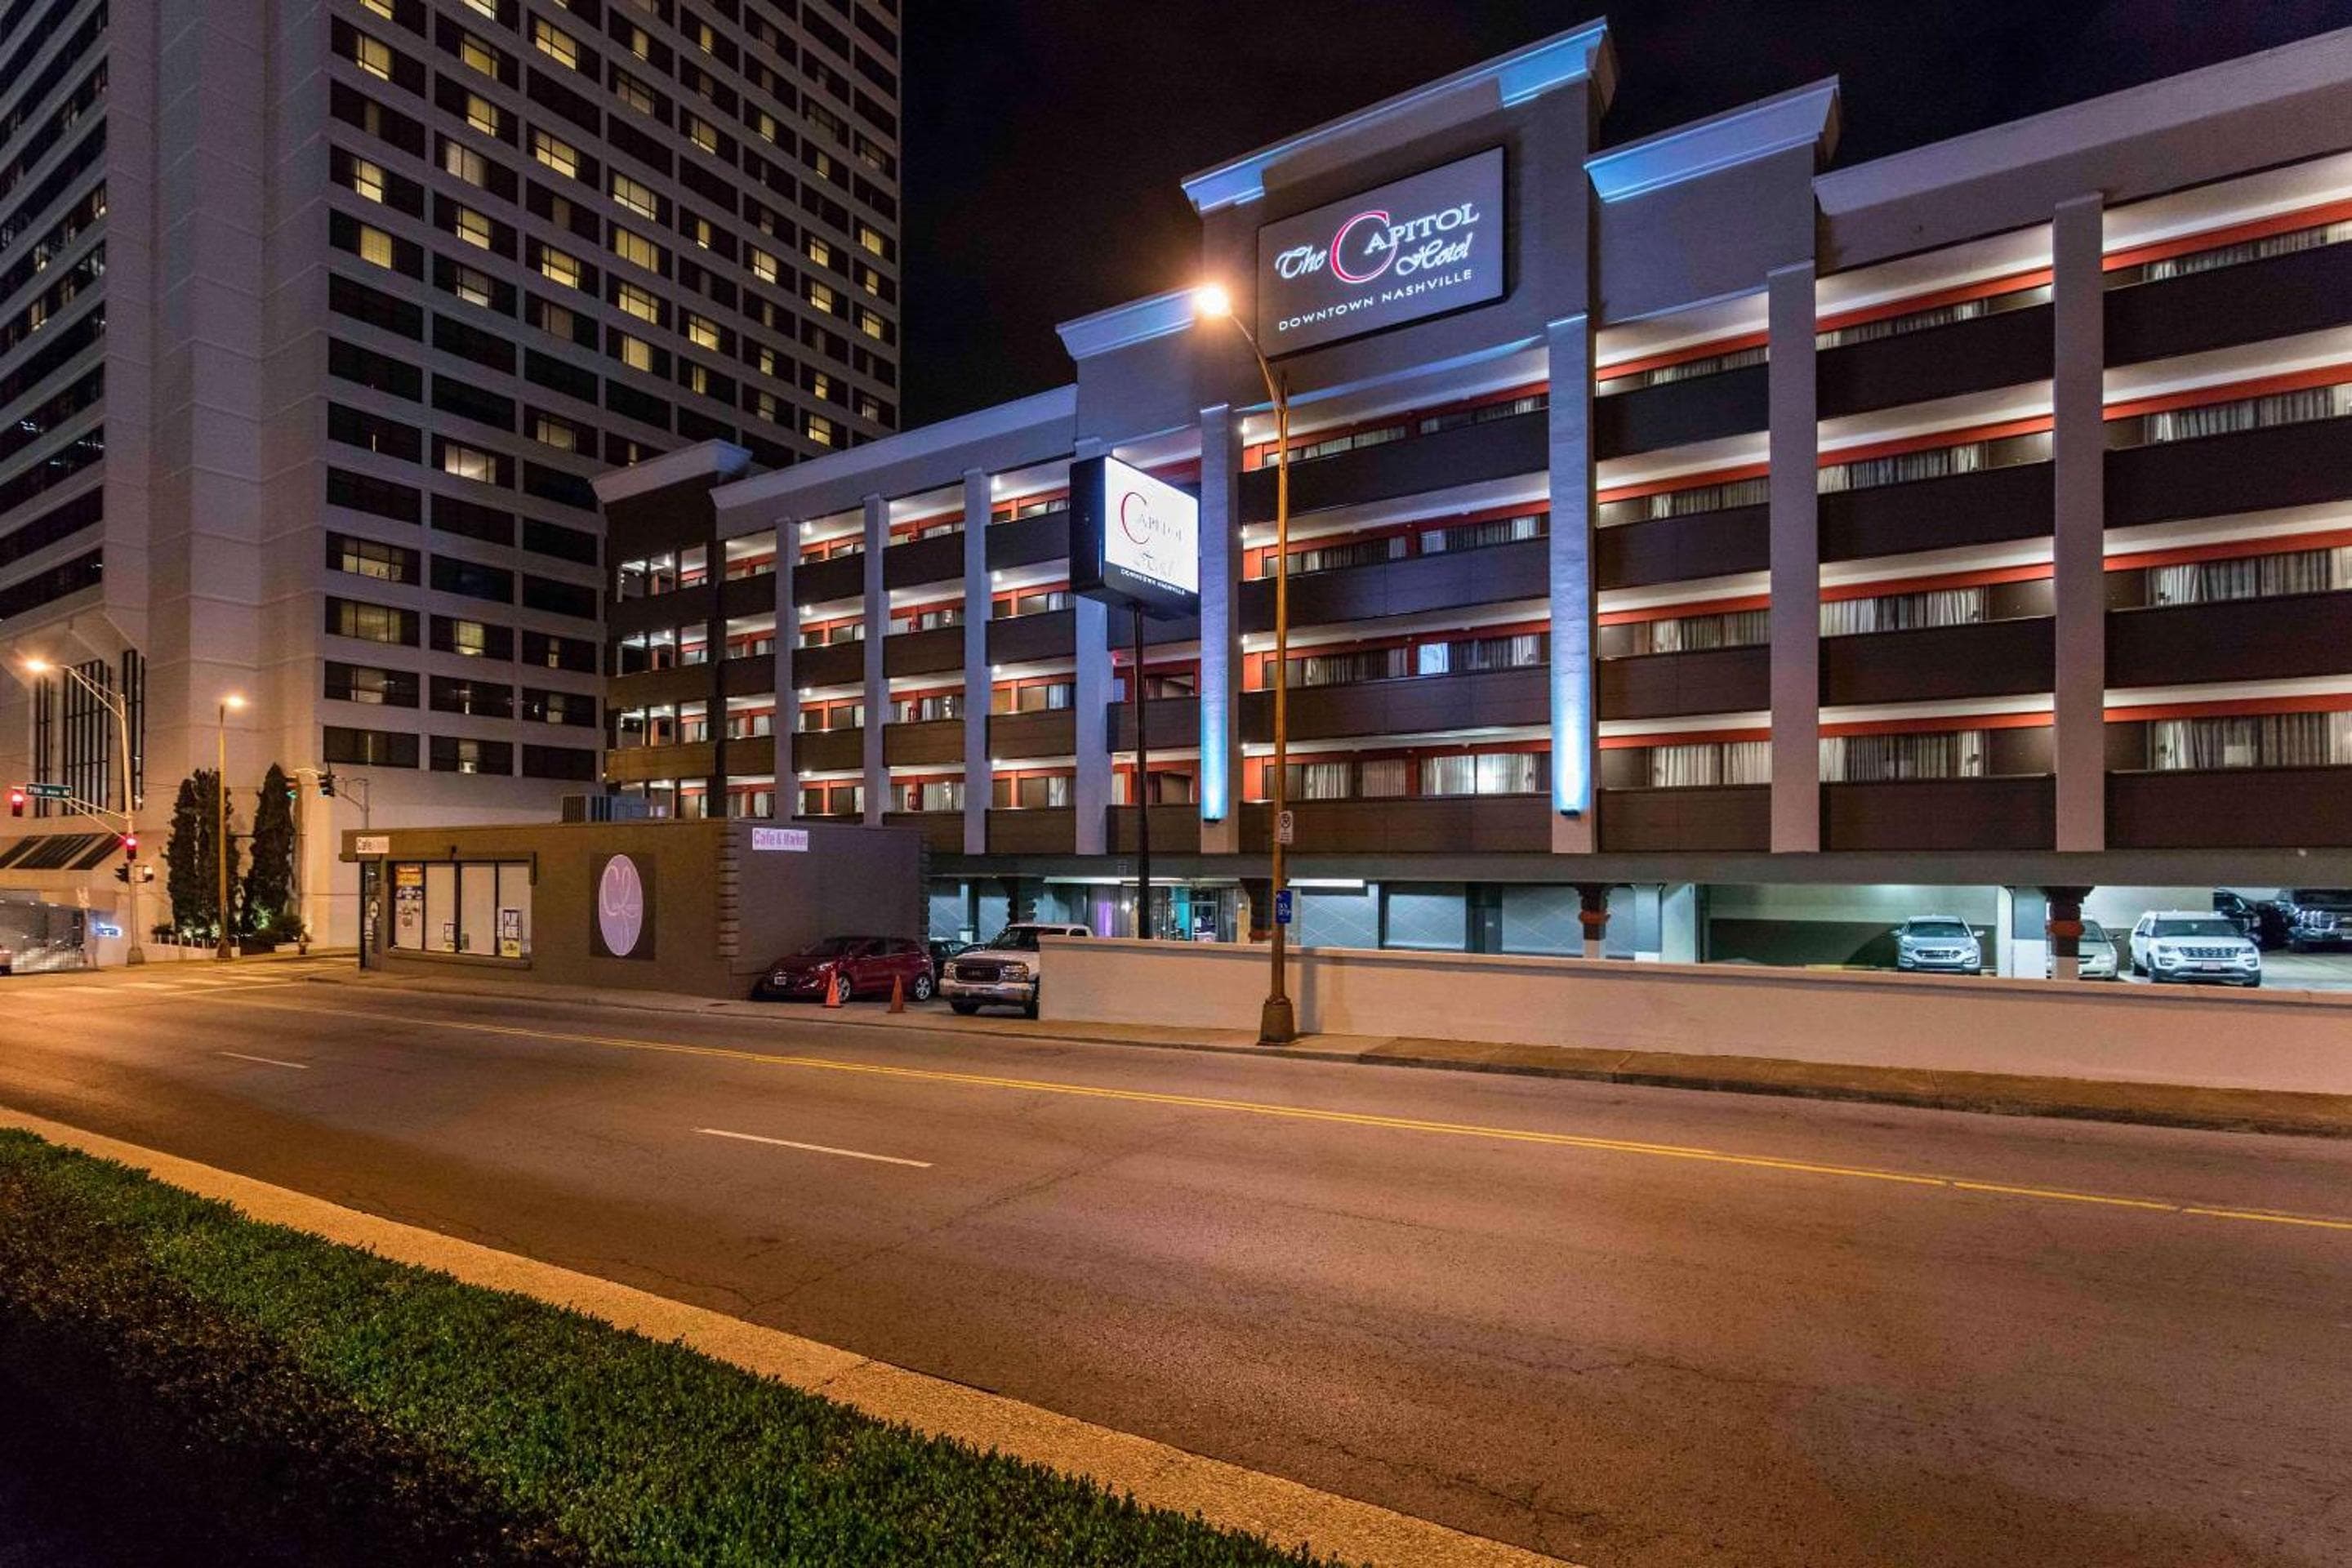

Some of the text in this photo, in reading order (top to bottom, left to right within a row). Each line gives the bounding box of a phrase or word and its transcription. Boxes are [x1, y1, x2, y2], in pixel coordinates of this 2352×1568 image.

[1275, 203, 1480, 284] The CAPITOL
[1395, 231, 1473, 275] Hotel
[1278, 268, 1472, 331] DOWNTOWN NASHVILLE
[753, 830, 776, 845] Cafe
